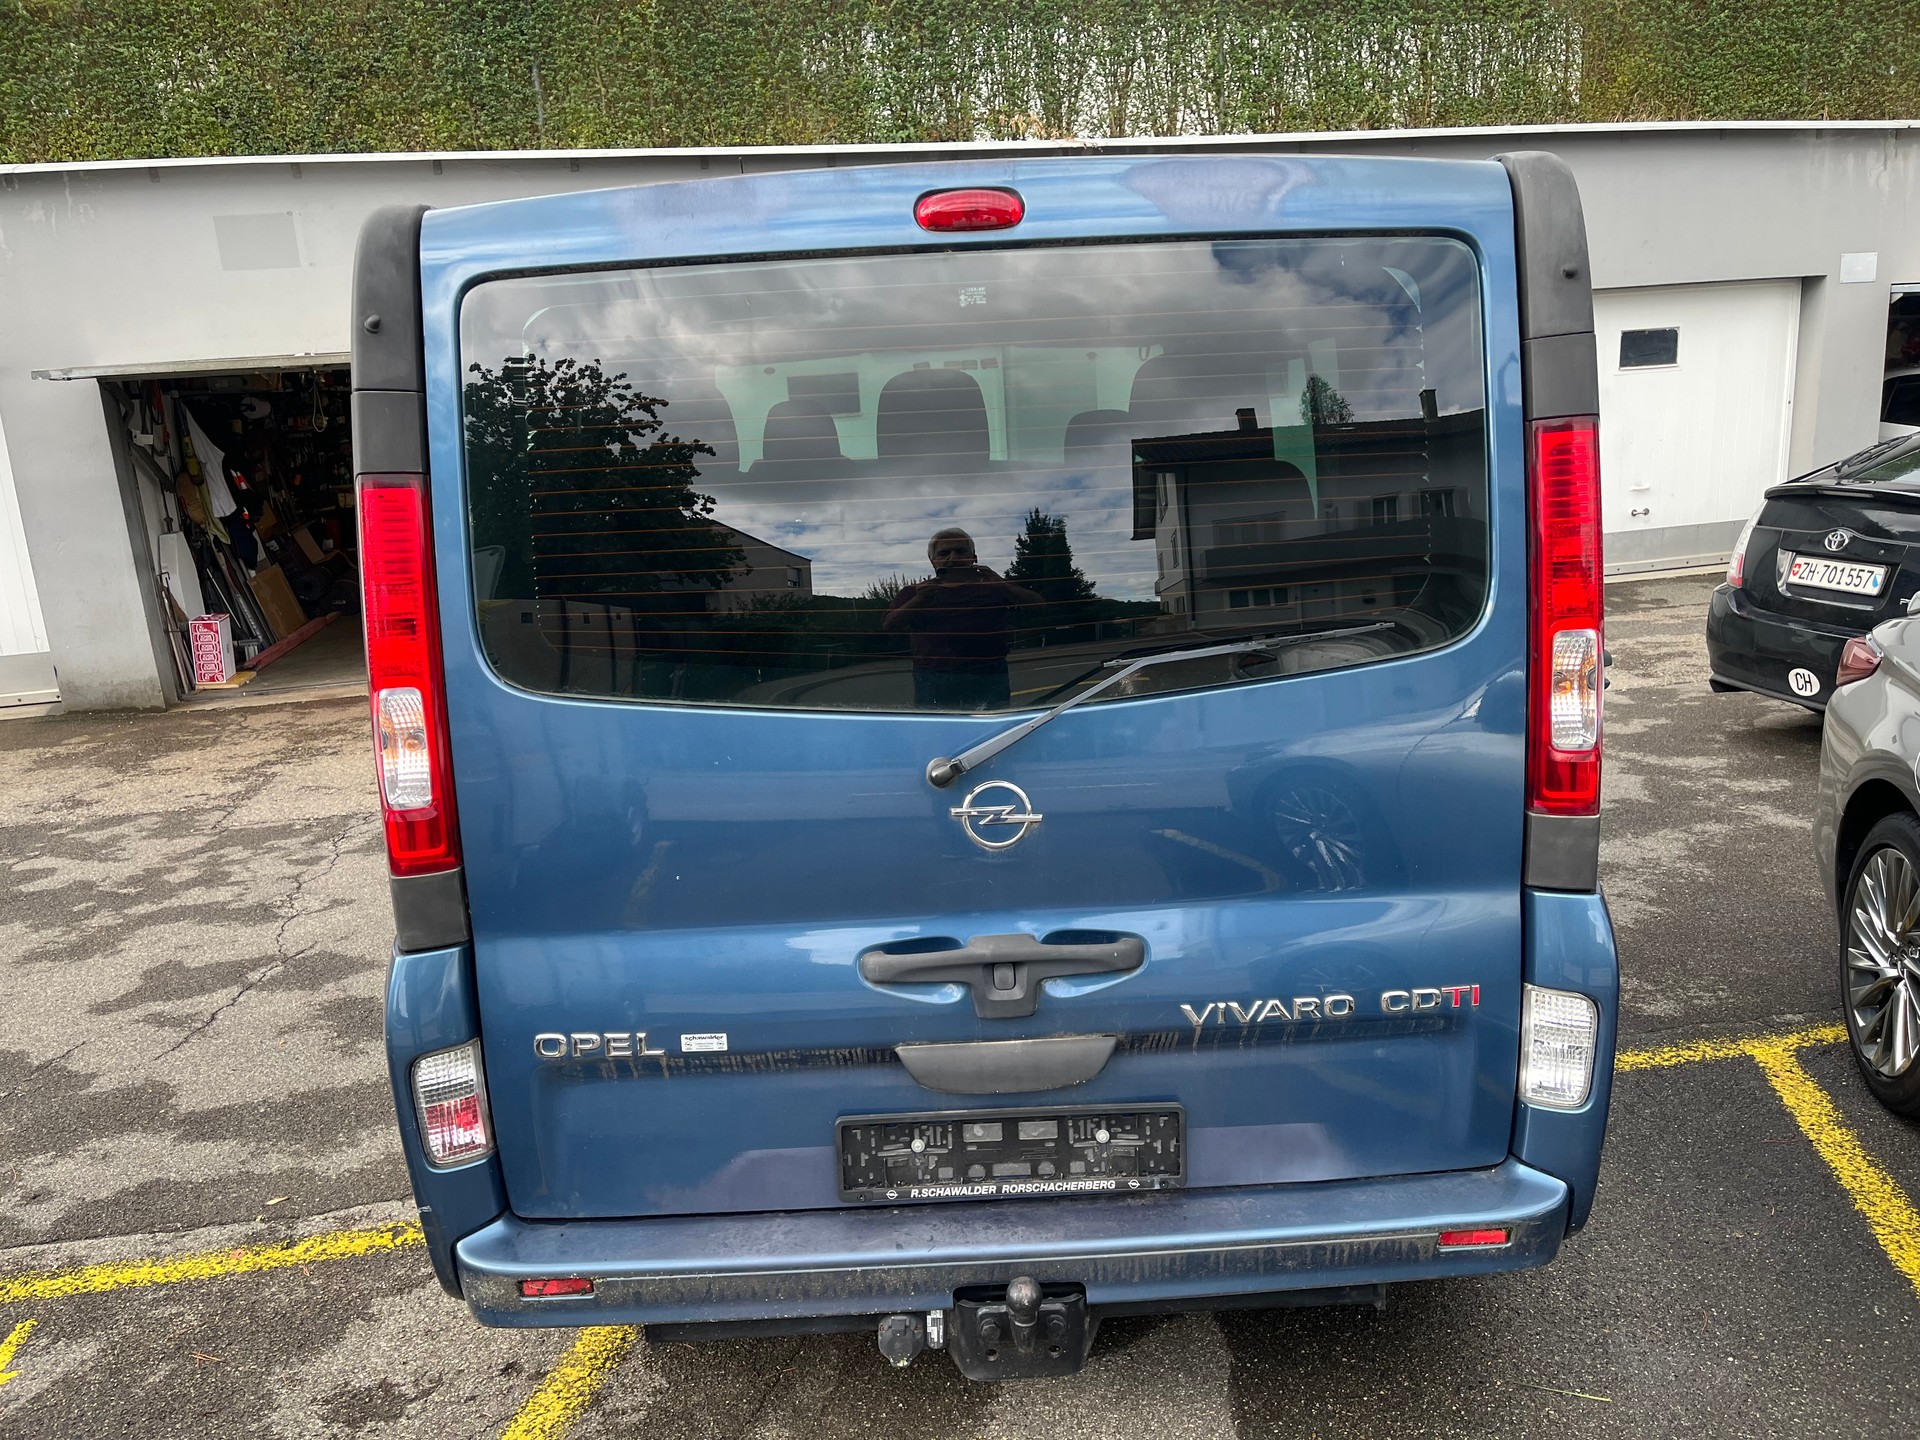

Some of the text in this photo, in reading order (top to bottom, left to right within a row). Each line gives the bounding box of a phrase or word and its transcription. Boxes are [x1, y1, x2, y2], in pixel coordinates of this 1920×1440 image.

[1795, 672, 1813, 693] CH
[1180, 984, 1481, 1026] VIVARO CDTI
[533, 1032, 666, 1058] OPEL
[910, 1180, 1116, 1199] R.SCHAWALDER RORSCHACHERBERG
